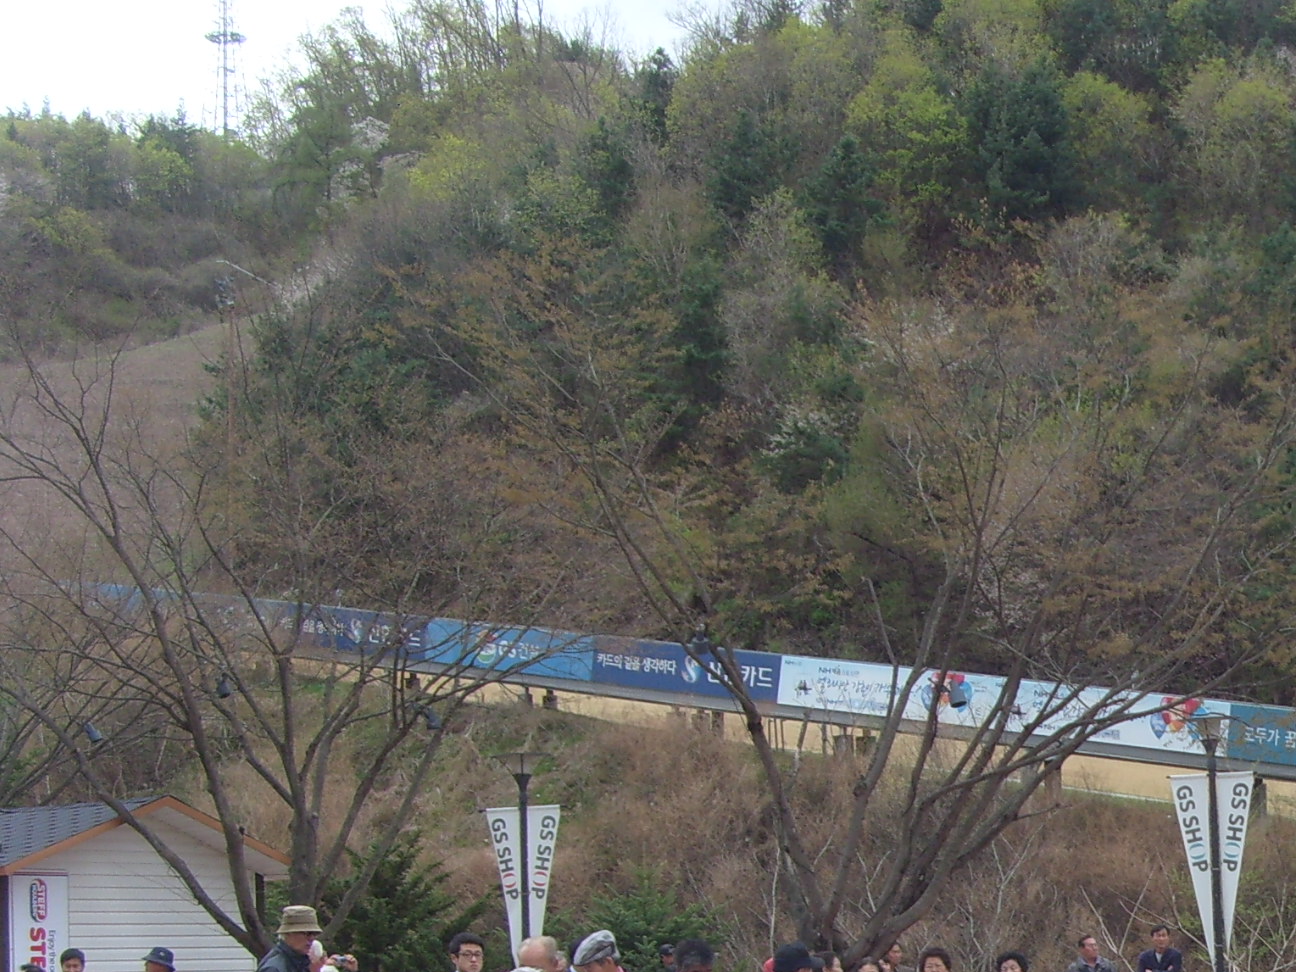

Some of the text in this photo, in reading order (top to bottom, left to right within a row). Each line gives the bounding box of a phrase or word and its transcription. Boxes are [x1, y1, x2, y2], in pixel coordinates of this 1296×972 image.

[642, 657, 677, 675] 생각하다
[1244, 726, 1280, 746] 모두가
[1176, 785, 1209, 872] GS SHOP
[1222, 782, 1249, 872] GS SHOP
[491, 818, 519, 900] GS SHOP
[531, 815, 556, 900] GS SHOP
[37, 884, 46, 916] STEFF
[48, 929, 56, 951] Enjoy
